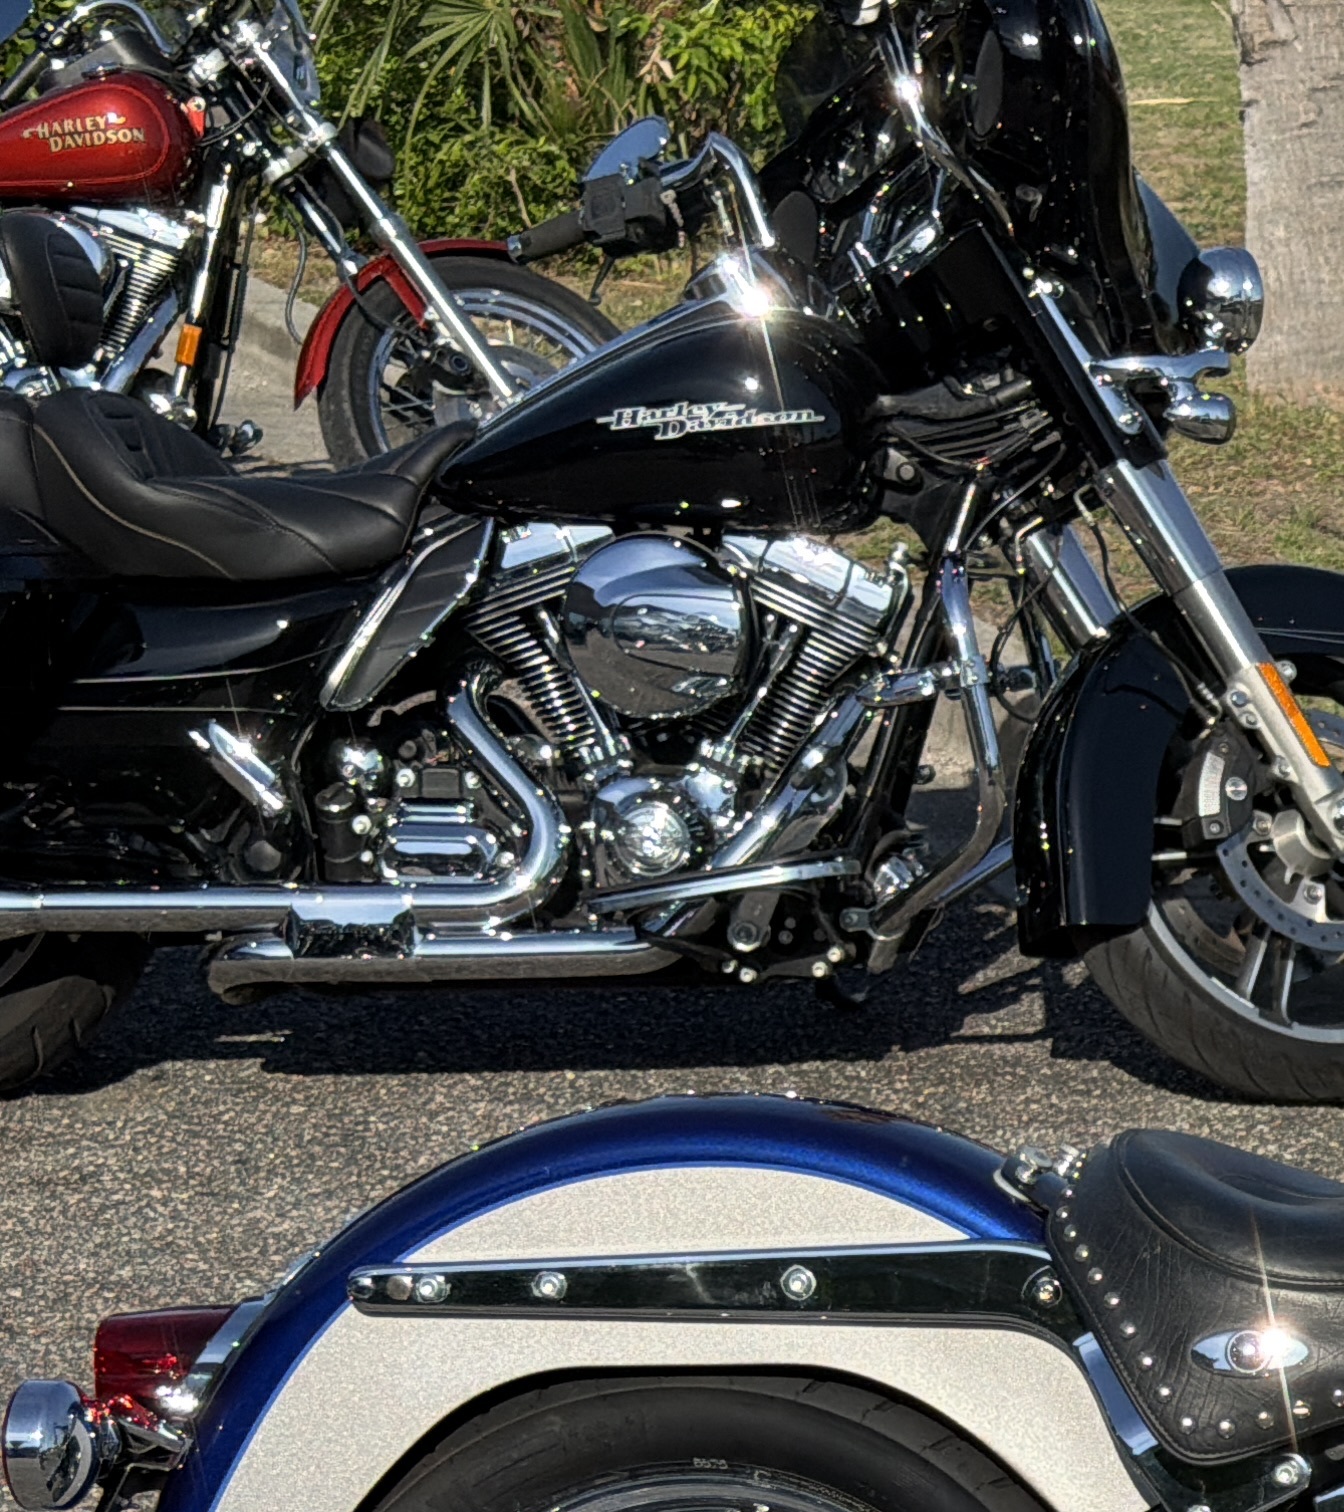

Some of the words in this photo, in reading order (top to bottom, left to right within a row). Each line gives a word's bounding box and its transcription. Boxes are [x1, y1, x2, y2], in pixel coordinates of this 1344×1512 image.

[23, 113, 118, 139] HARLEY
[49, 128, 146, 153] DAVIDSON
[600, 401, 742, 430] Harley
[654, 408, 825, 441] Davidson
